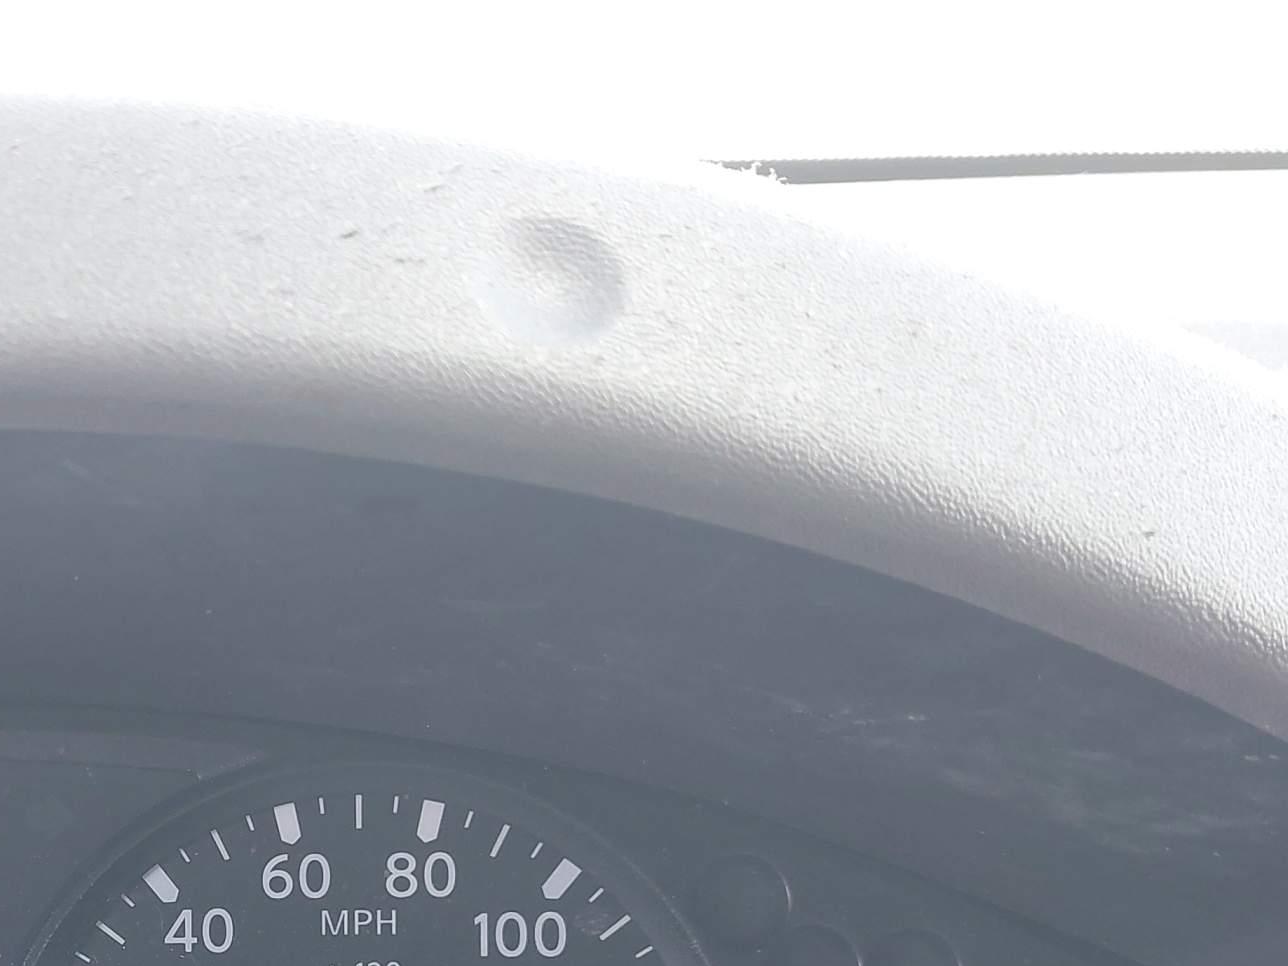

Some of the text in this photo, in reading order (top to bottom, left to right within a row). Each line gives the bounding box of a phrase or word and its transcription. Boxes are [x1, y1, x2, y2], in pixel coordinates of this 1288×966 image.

[262, 853, 331, 900] 60
[384, 852, 456, 899] 80
[164, 908, 234, 955] 40
[320, 909, 398, 938] MPH
[475, 911, 566, 959] 100
